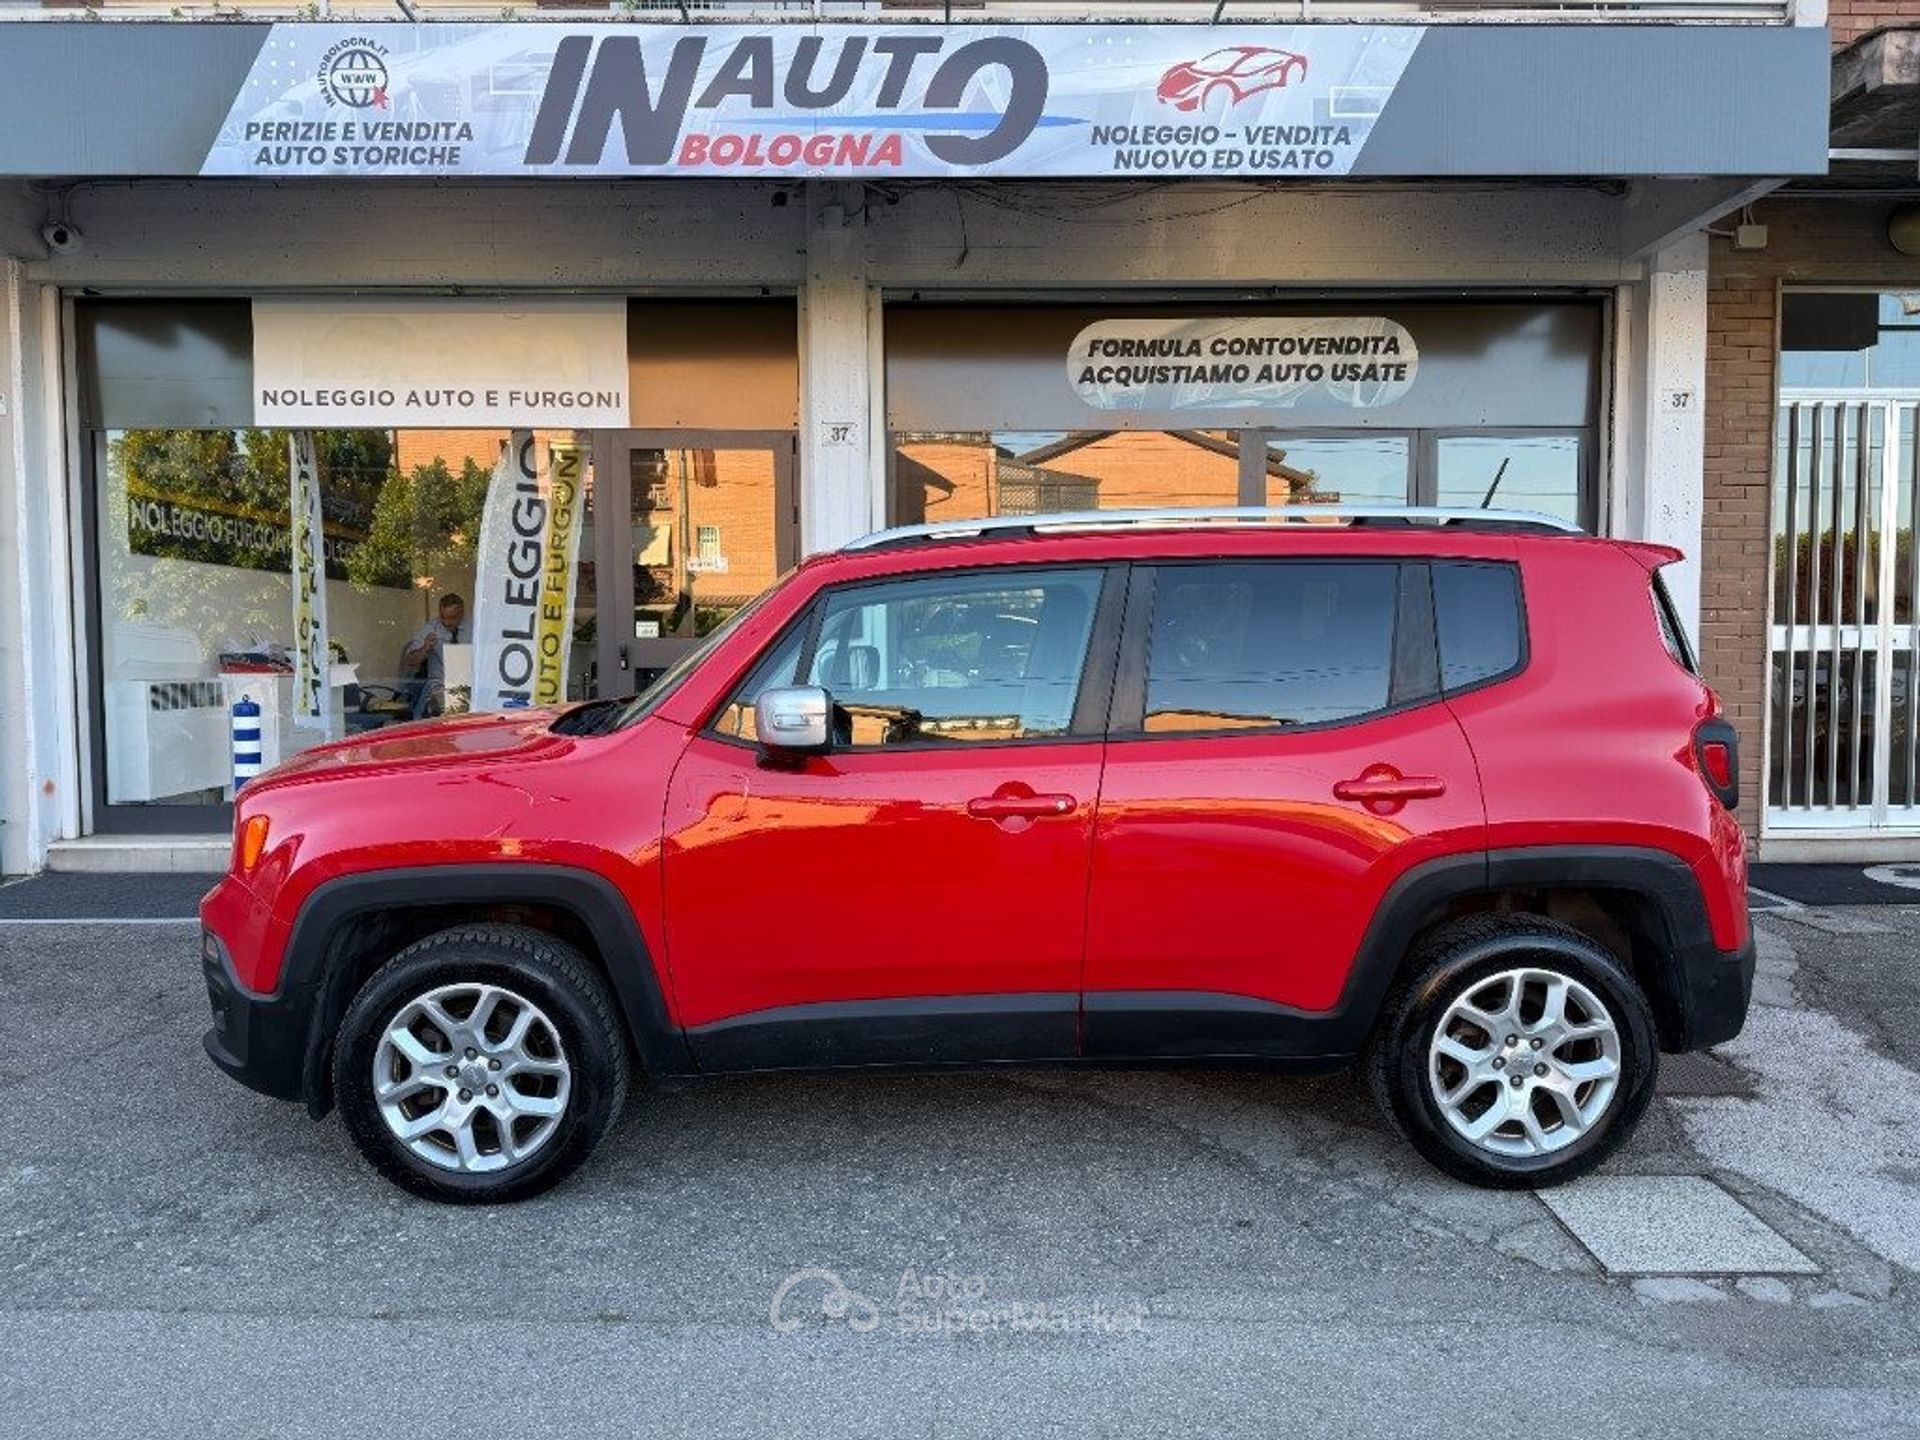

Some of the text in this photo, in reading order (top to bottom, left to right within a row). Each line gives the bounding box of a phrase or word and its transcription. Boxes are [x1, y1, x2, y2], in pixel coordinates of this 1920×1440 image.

[244, 122, 474, 142] PERIZIE E VENDITA
[1091, 125, 1219, 146] NOLEGGIO
[1243, 126, 1351, 145] VENDITA
[255, 146, 461, 166] AUTO STORICHE
[677, 134, 903, 167] BOLOGNA
[1113, 149, 1333, 168] NUOVO ED USATO
[1087, 336, 1401, 358] FORMULA CONTOVENDITA
[1078, 363, 1407, 387] ACQUISTIAMO AUTO USATE
[262, 390, 621, 408] NOLEGGIO AUTO E FURGONI
[1672, 393, 1689, 408] 37
[831, 427, 849, 441] 37
[130, 499, 223, 544] NOLEGGIO
[544, 603, 562, 621] E
